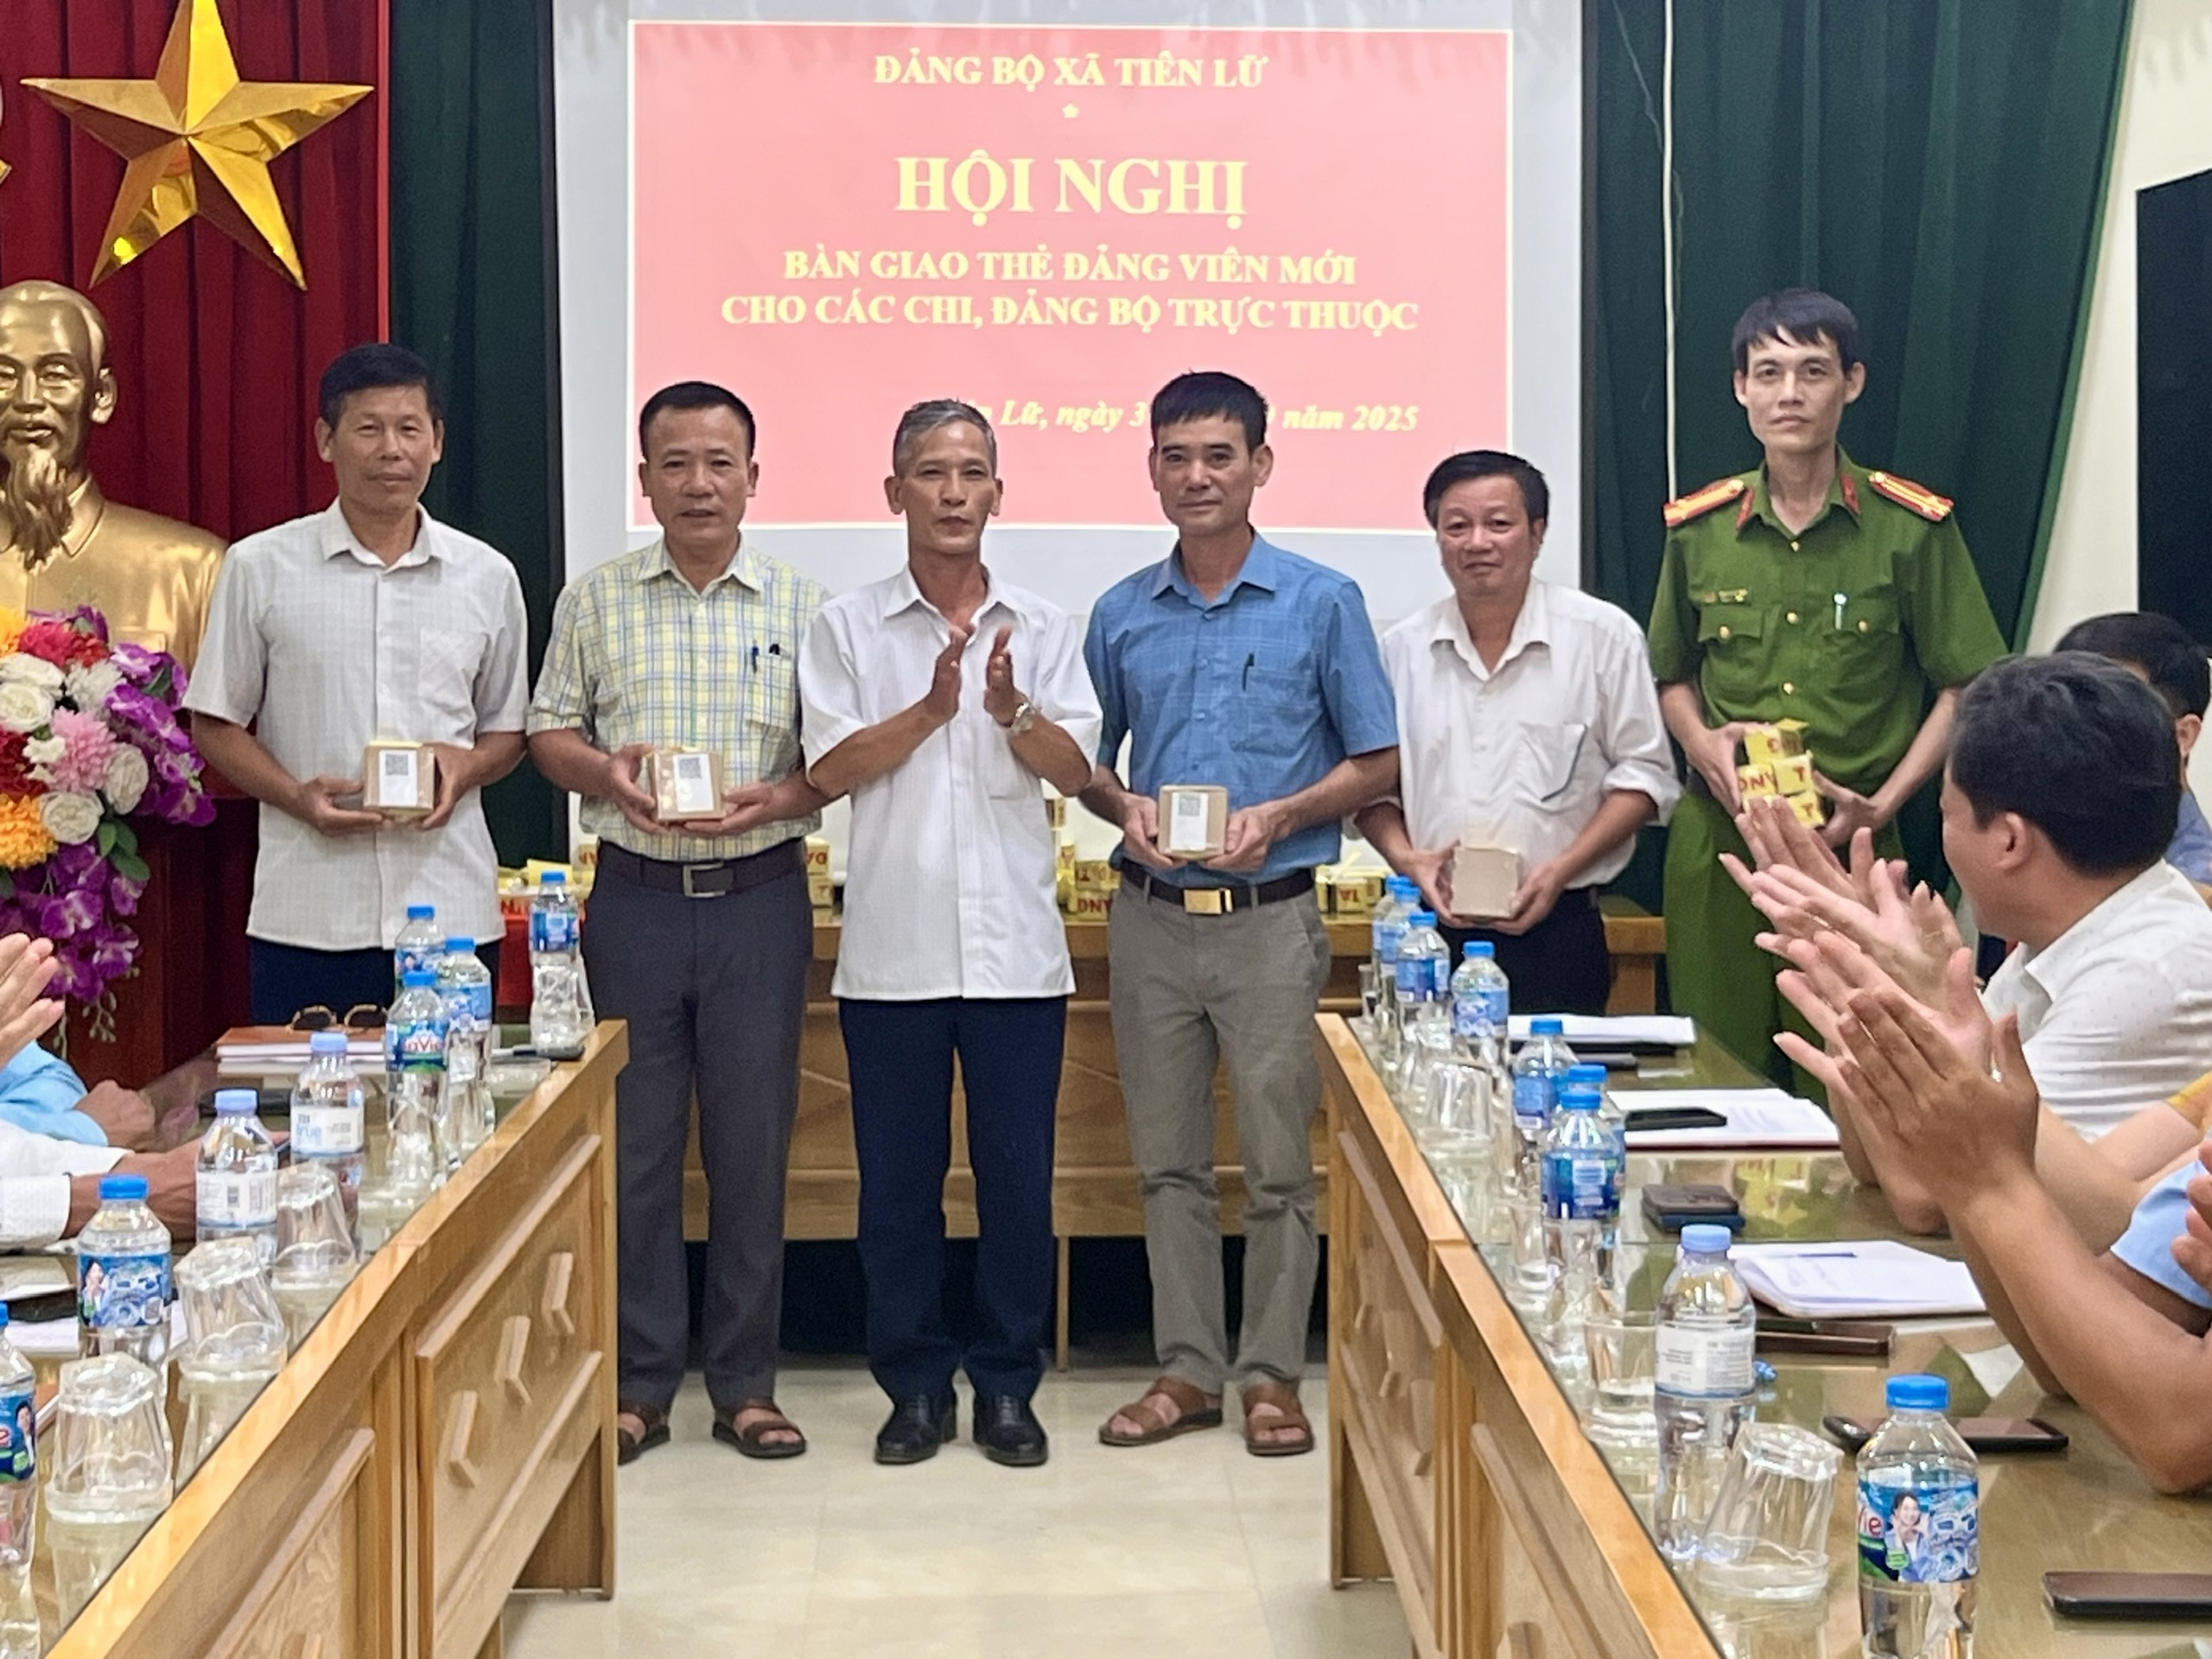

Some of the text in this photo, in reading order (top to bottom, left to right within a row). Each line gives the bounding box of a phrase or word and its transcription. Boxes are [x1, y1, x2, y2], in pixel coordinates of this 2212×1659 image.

[874, 48, 1268, 91] ĐẢNG BỘ XÃ TIÊN LỮ
[895, 149, 1249, 229] HỘI NGHỊ
[783, 243, 1357, 285] BÀN GIAO THẺ ĐẢNG VIÊN MỚI
[721, 287, 1419, 336] CHO CÁC CHI, ĐẢNG BỘ TRỰC THUỘC
[1055, 400, 1125, 431] ngày
[1282, 404, 1345, 429] năm
[1351, 404, 1419, 430] 2025
